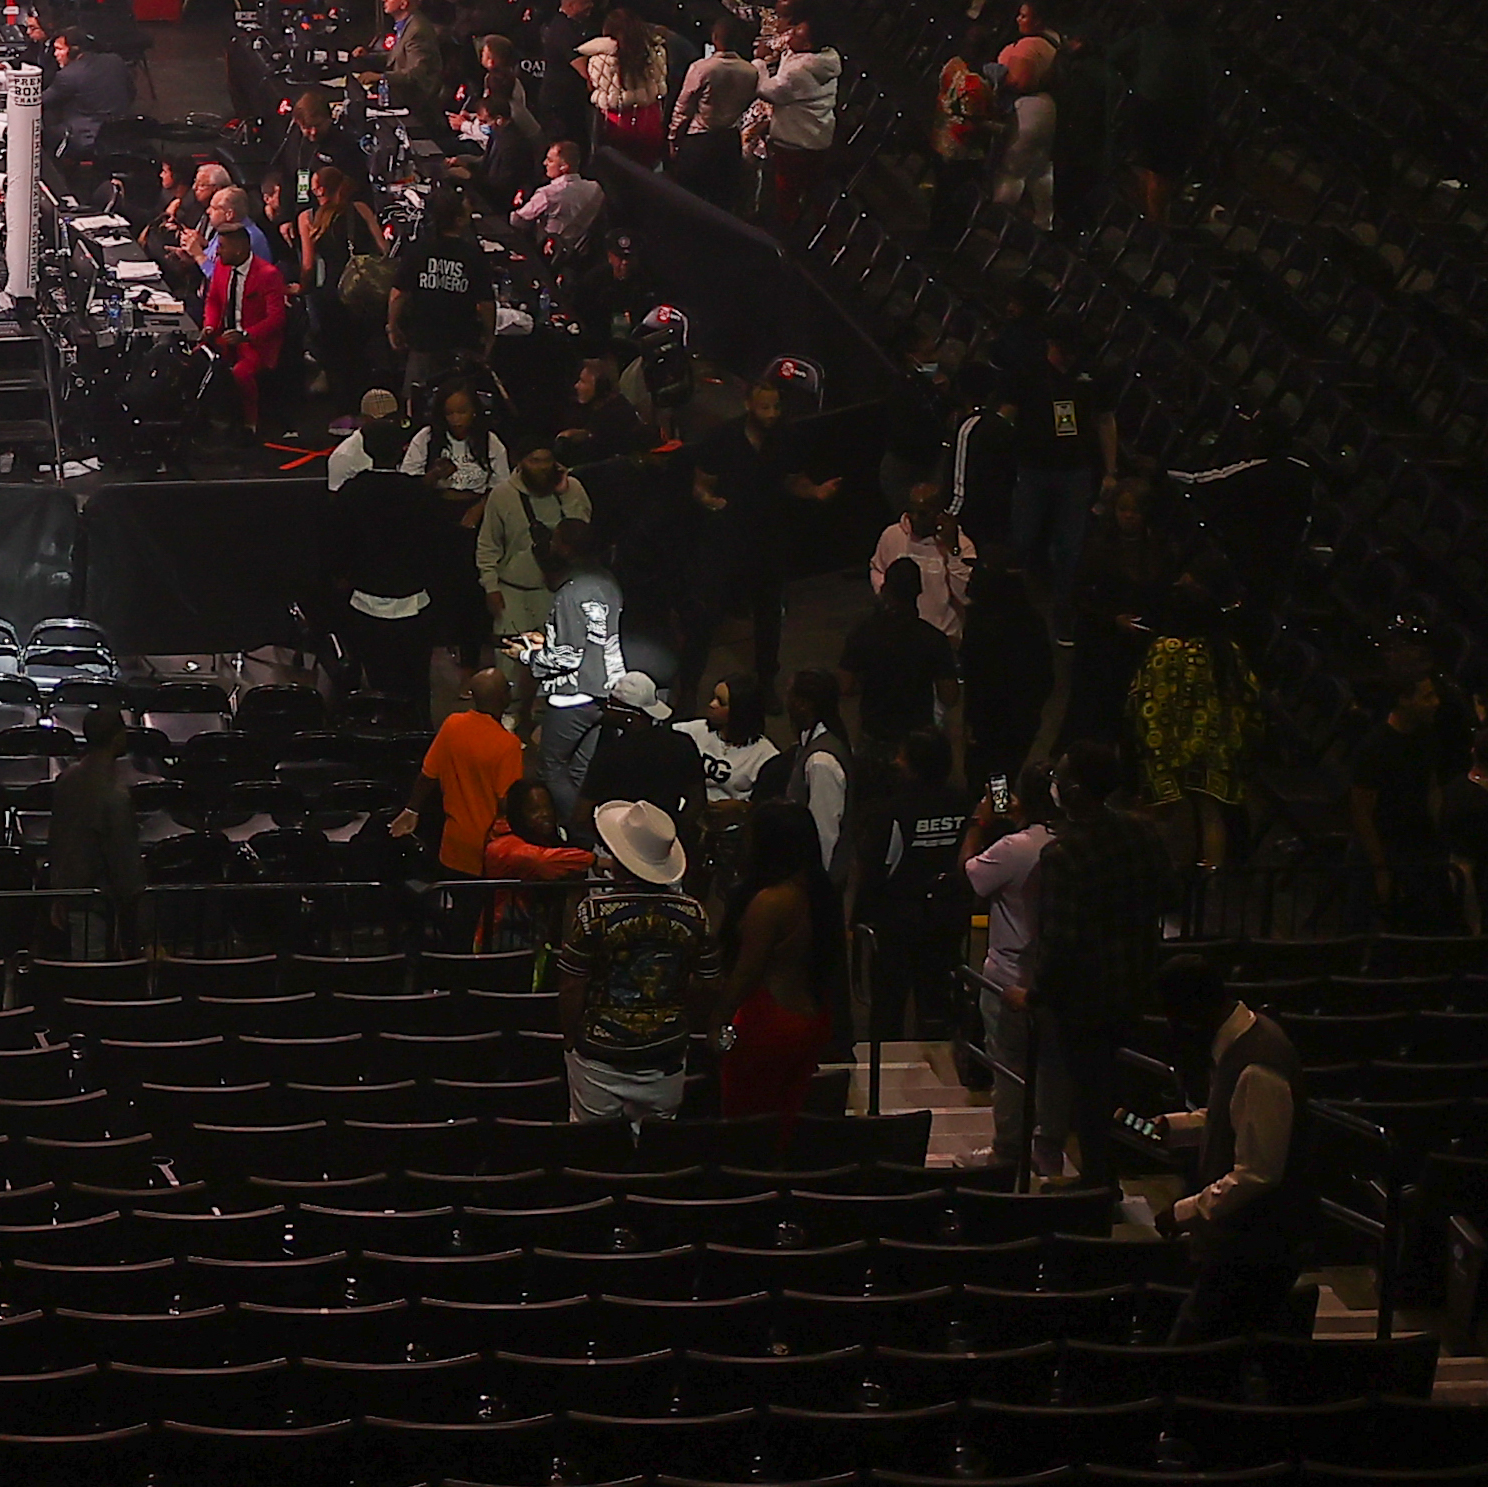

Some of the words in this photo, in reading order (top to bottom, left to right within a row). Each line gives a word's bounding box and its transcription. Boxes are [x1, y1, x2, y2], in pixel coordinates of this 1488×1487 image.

[427, 256, 465, 278] DAVIS
[418, 272, 470, 294] ROMERO
[915, 815, 967, 833] BEST
